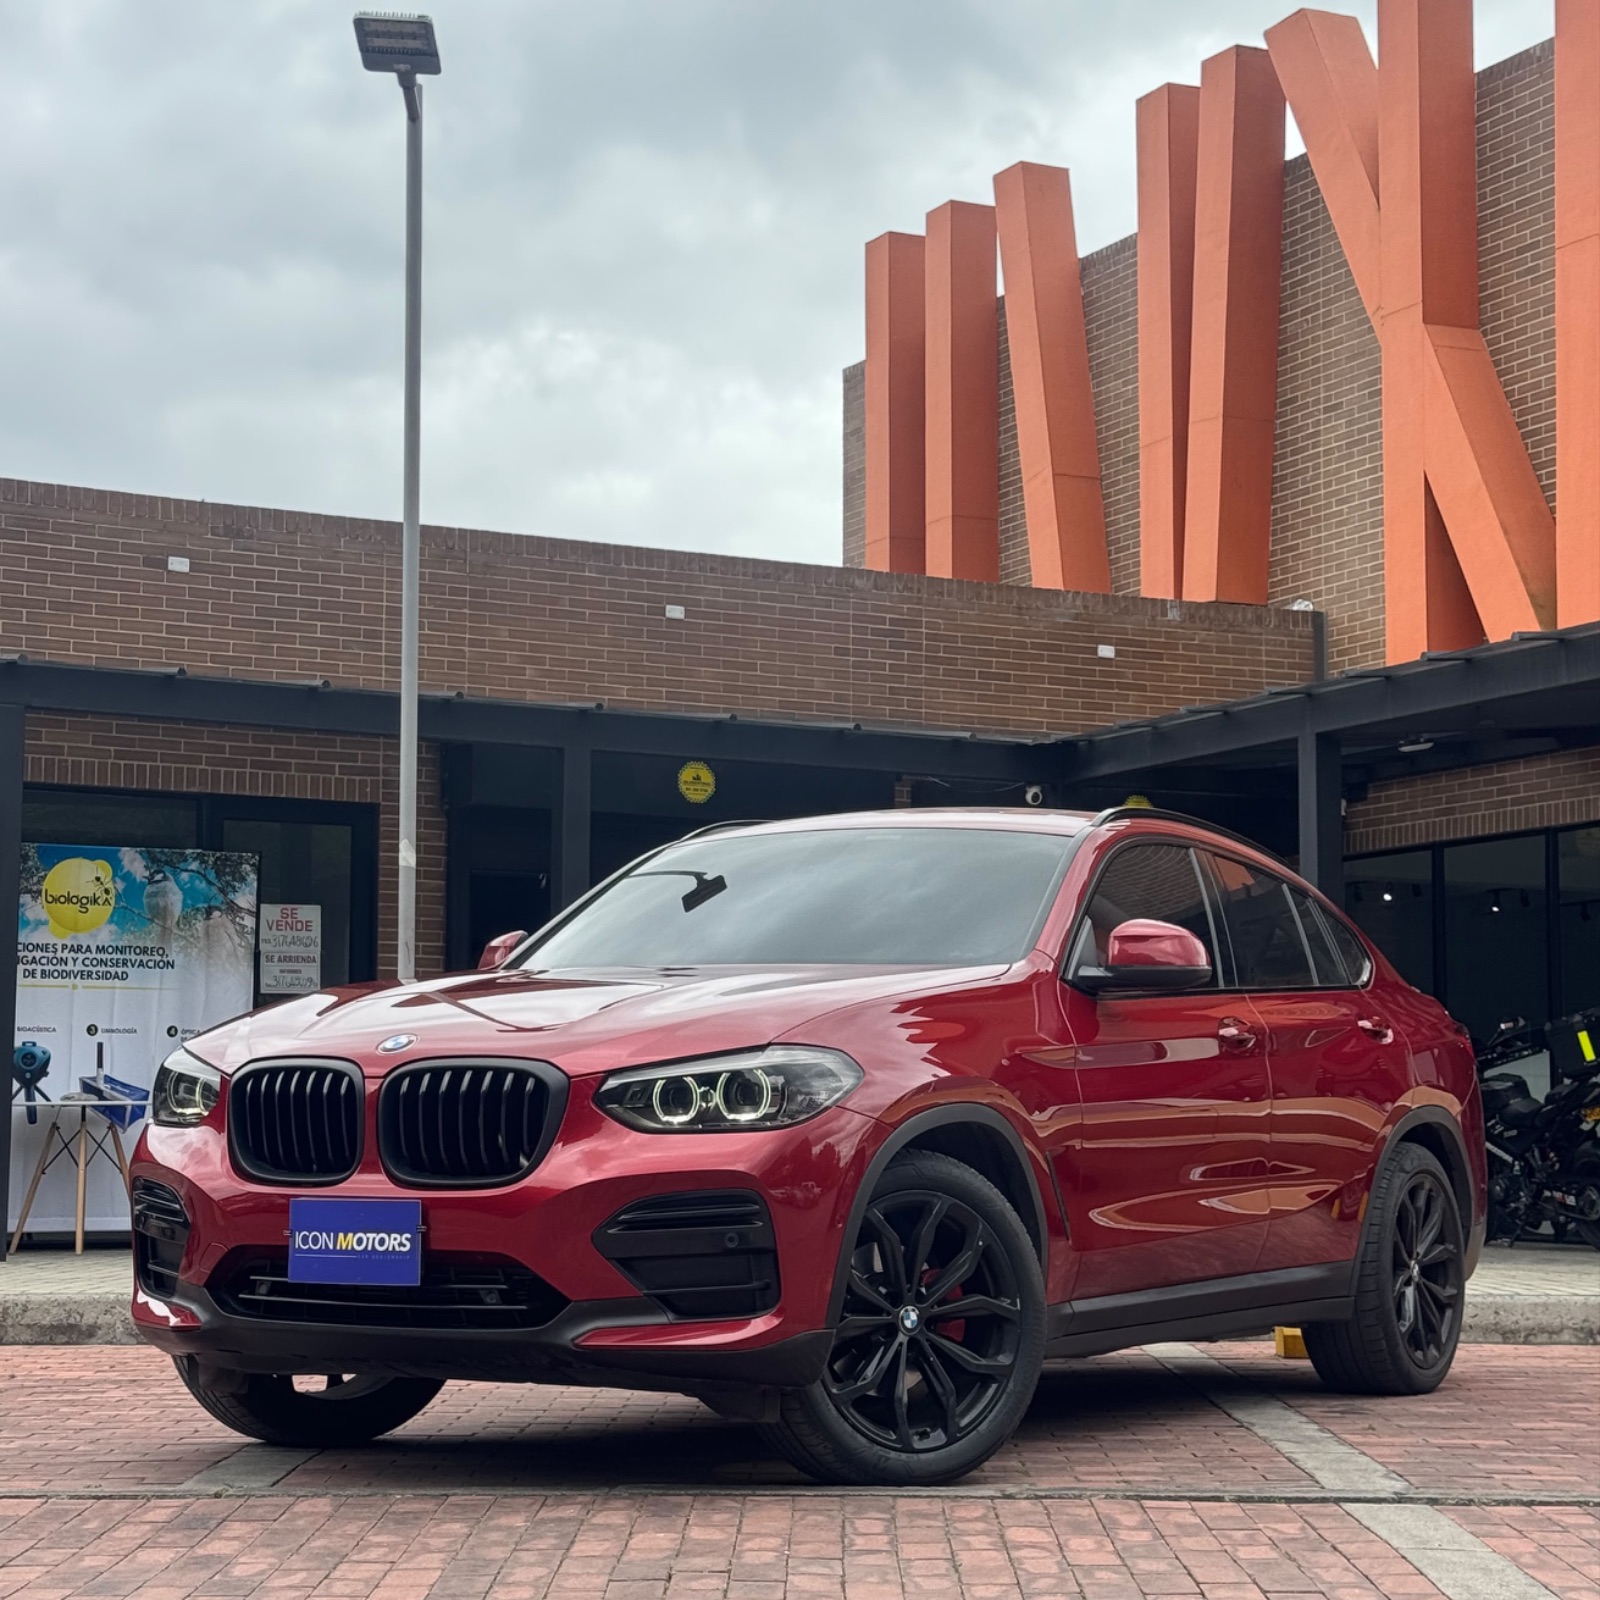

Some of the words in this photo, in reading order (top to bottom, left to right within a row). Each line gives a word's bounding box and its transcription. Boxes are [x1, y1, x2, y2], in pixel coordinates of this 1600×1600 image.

[280, 907, 299, 919] SE
[266, 919, 313, 932] VENDE
[61, 943, 93, 955] PARA
[95, 944, 169, 959] MONITOREO,
[71, 956, 79, 967] Y
[81, 955, 175, 969] CONSERVACIÓN
[265, 954, 276, 964] SE
[277, 954, 317, 964] ARRIENDA
[22, 968, 37, 979] DE
[40, 968, 129, 981] BIODIVERSIDAD
[295, 1231, 334, 1250] ICON
[336, 1232, 412, 1252] MOTORS
